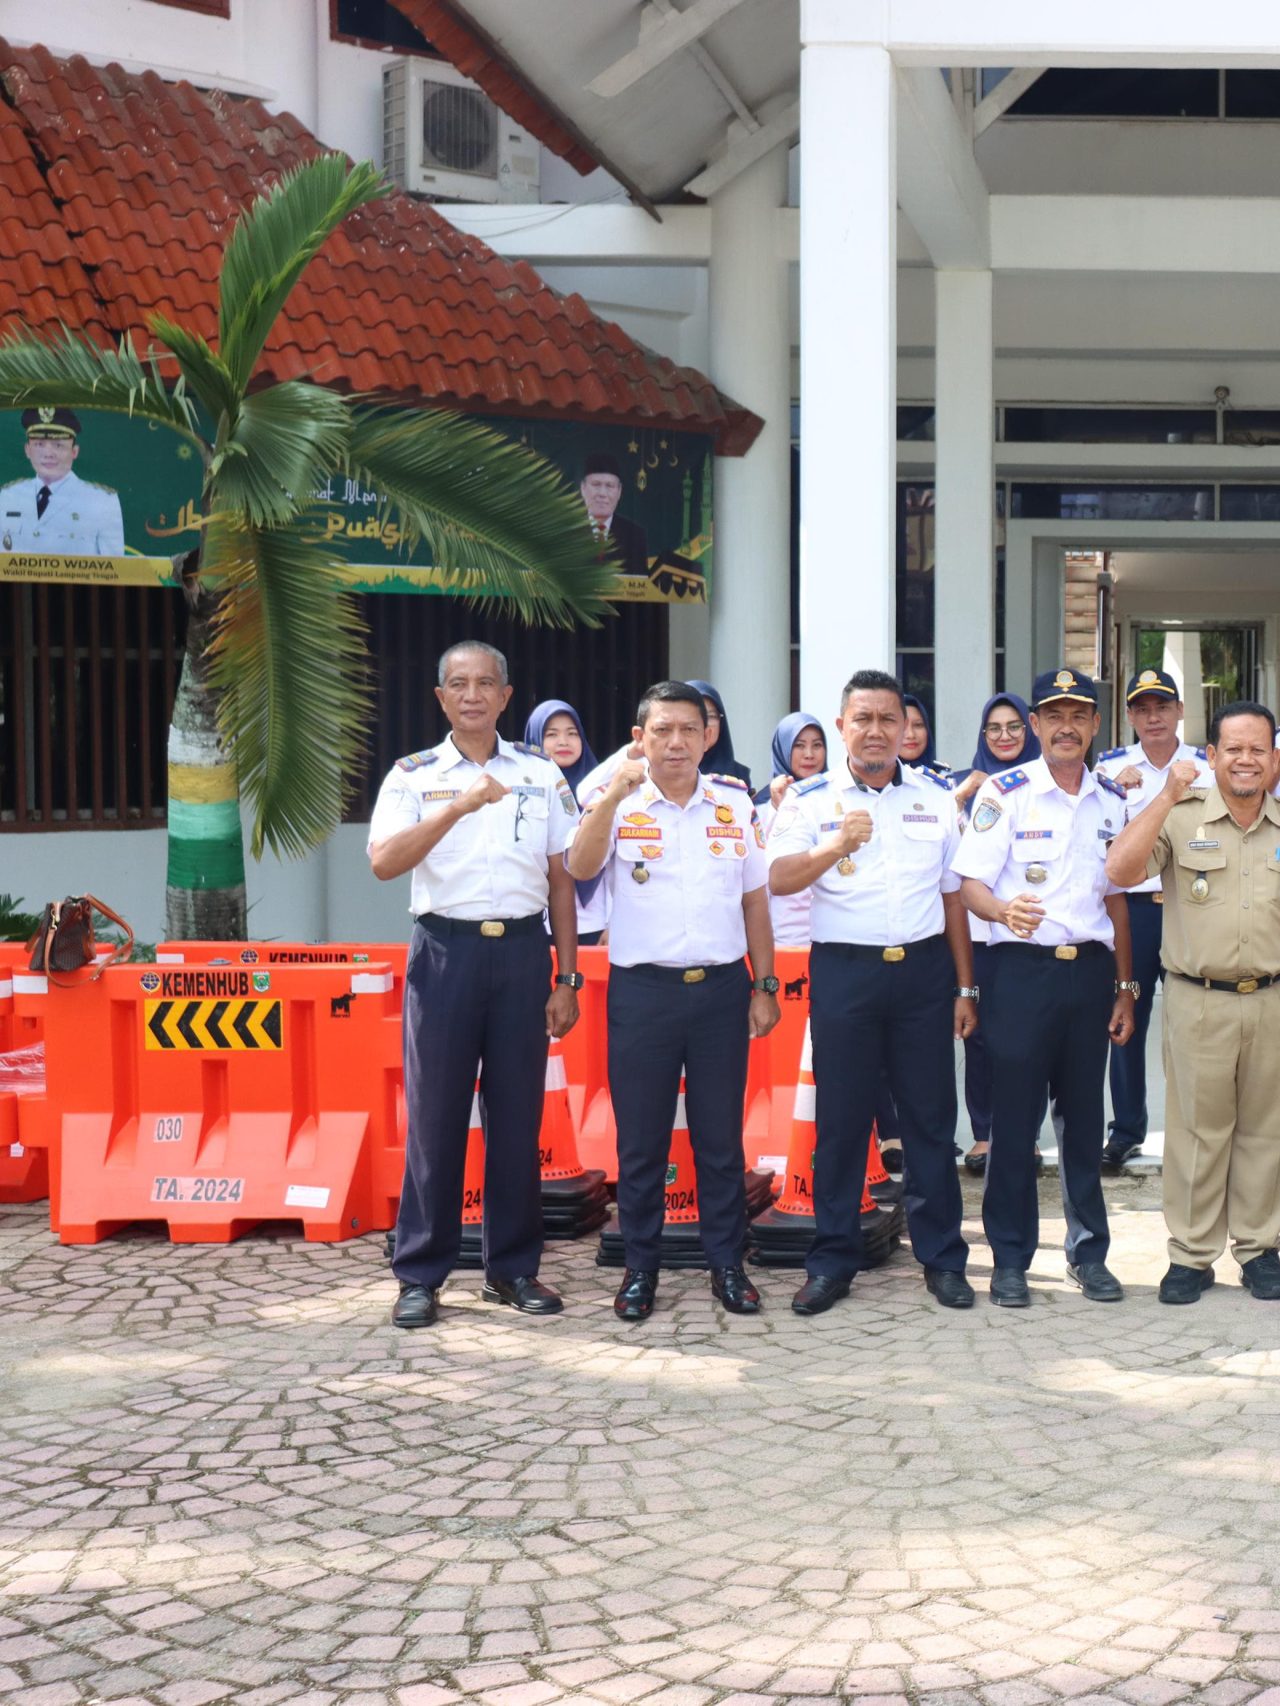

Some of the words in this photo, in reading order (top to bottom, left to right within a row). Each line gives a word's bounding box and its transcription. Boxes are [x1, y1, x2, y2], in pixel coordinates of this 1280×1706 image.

[8, 557, 60, 568] ARDITO
[64, 559, 114, 570] WIJAYA
[709, 828, 742, 838] DISHUB
[162, 972, 249, 996] KEMENHUB
[157, 1118, 181, 1140] 030
[155, 1178, 183, 1200] TA.
[191, 1178, 241, 1201] 2024
[793, 1175, 811, 1197] TA.
[665, 1189, 695, 1210] 2024
